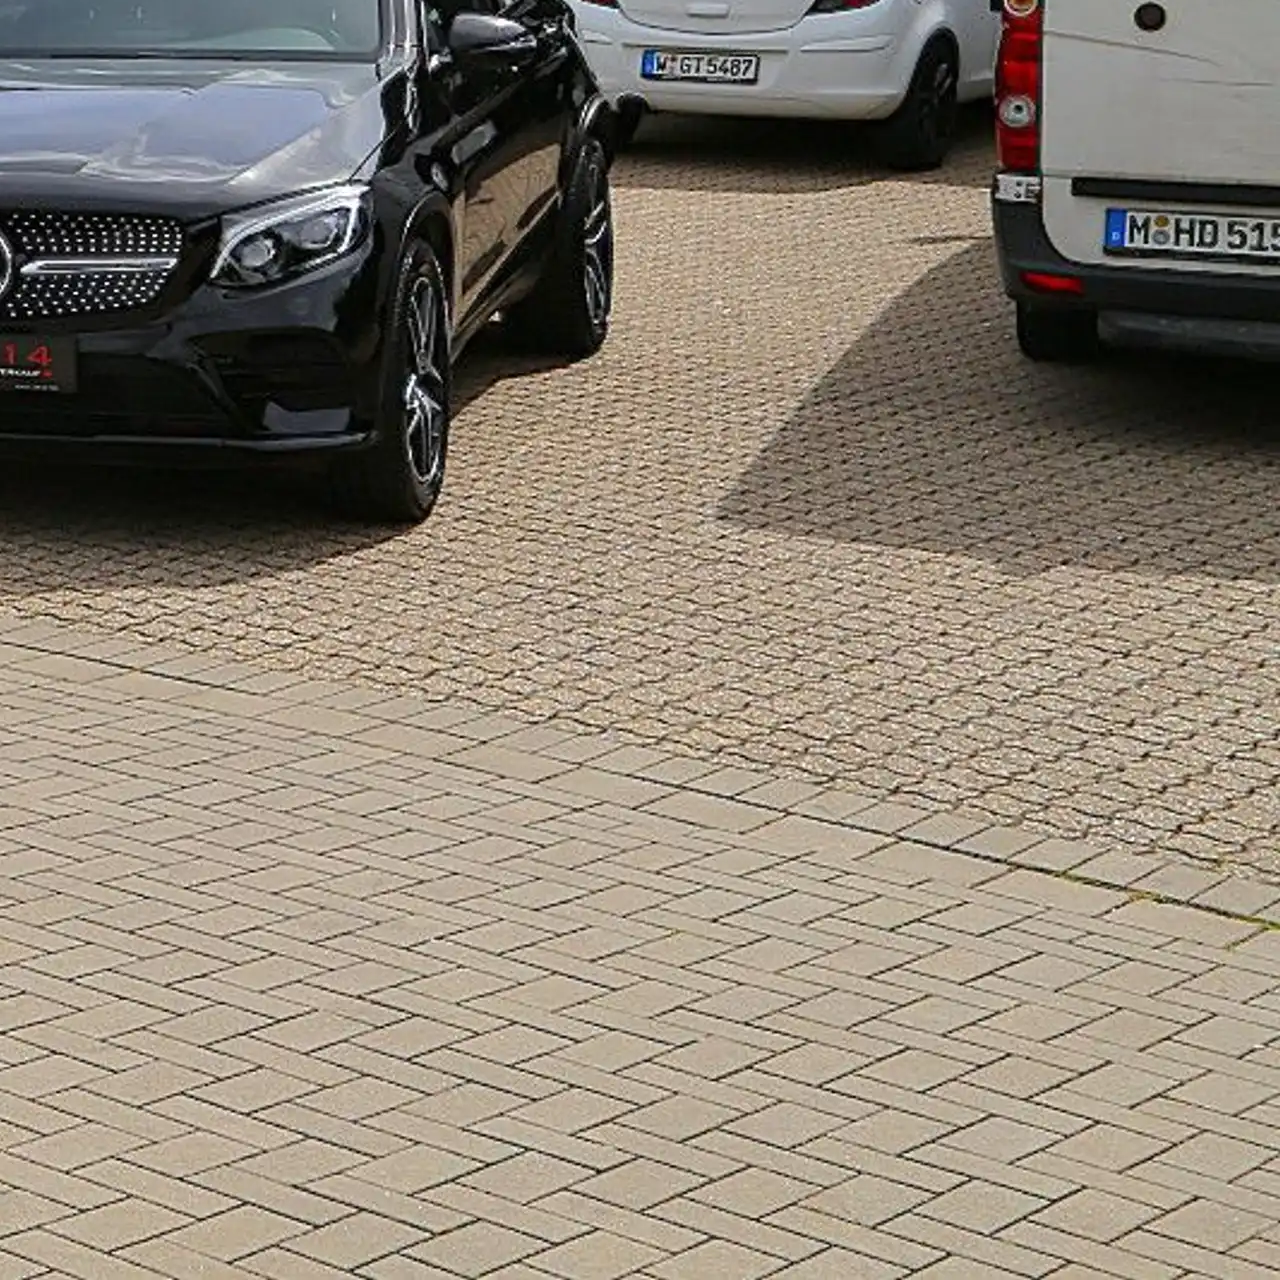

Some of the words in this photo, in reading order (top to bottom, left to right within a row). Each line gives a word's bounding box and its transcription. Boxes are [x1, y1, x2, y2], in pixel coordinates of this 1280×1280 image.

[1128, 215, 1151, 245] M
[1174, 218, 1219, 248] HD
[3, 342, 53, 368] 14
